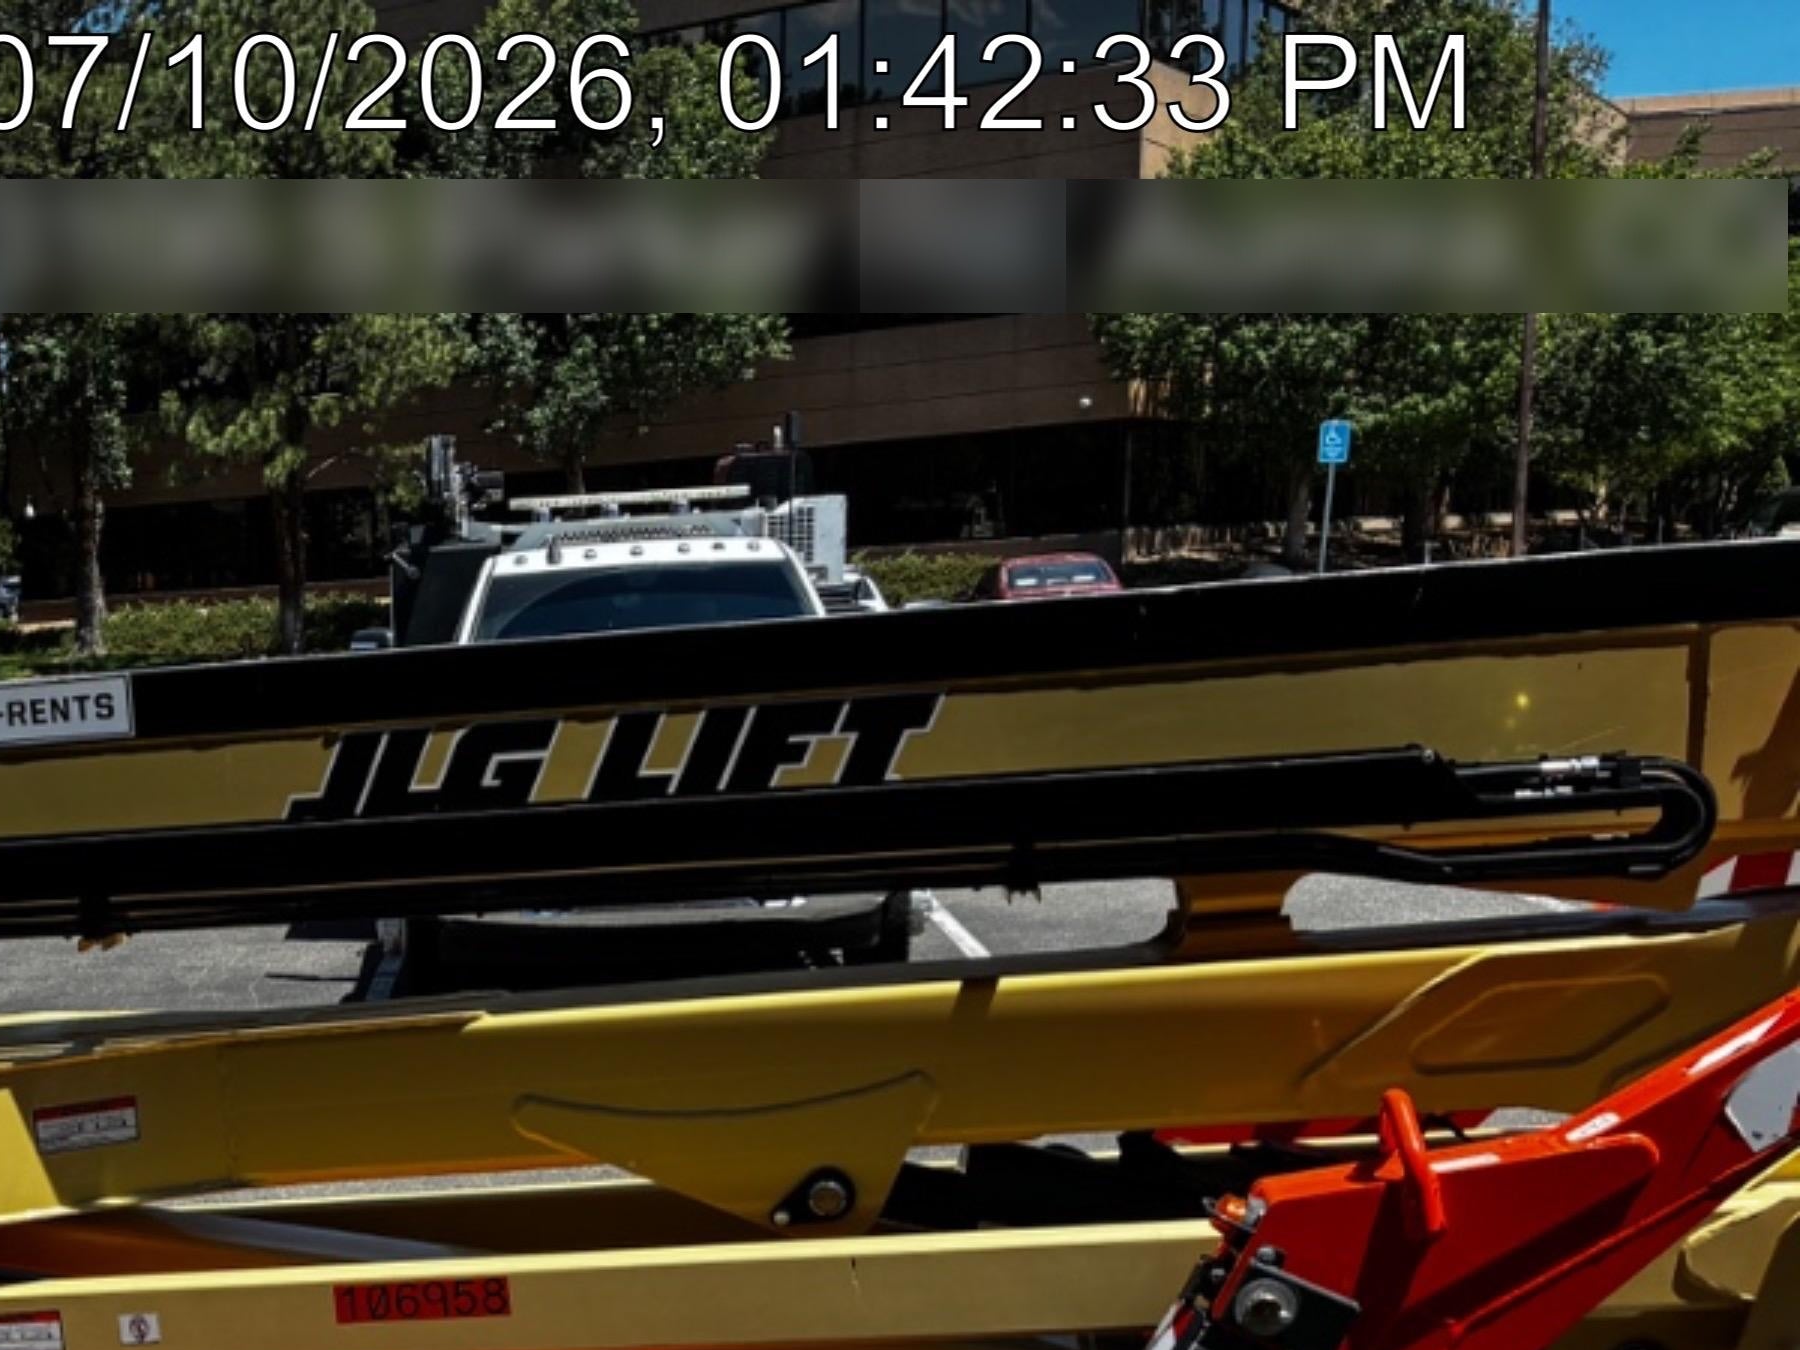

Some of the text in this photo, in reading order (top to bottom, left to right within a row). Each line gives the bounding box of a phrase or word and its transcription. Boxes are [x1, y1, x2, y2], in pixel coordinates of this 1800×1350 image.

[280, 692, 946, 820] JLG LIFT
[342, 1278, 508, 1321] 106958
